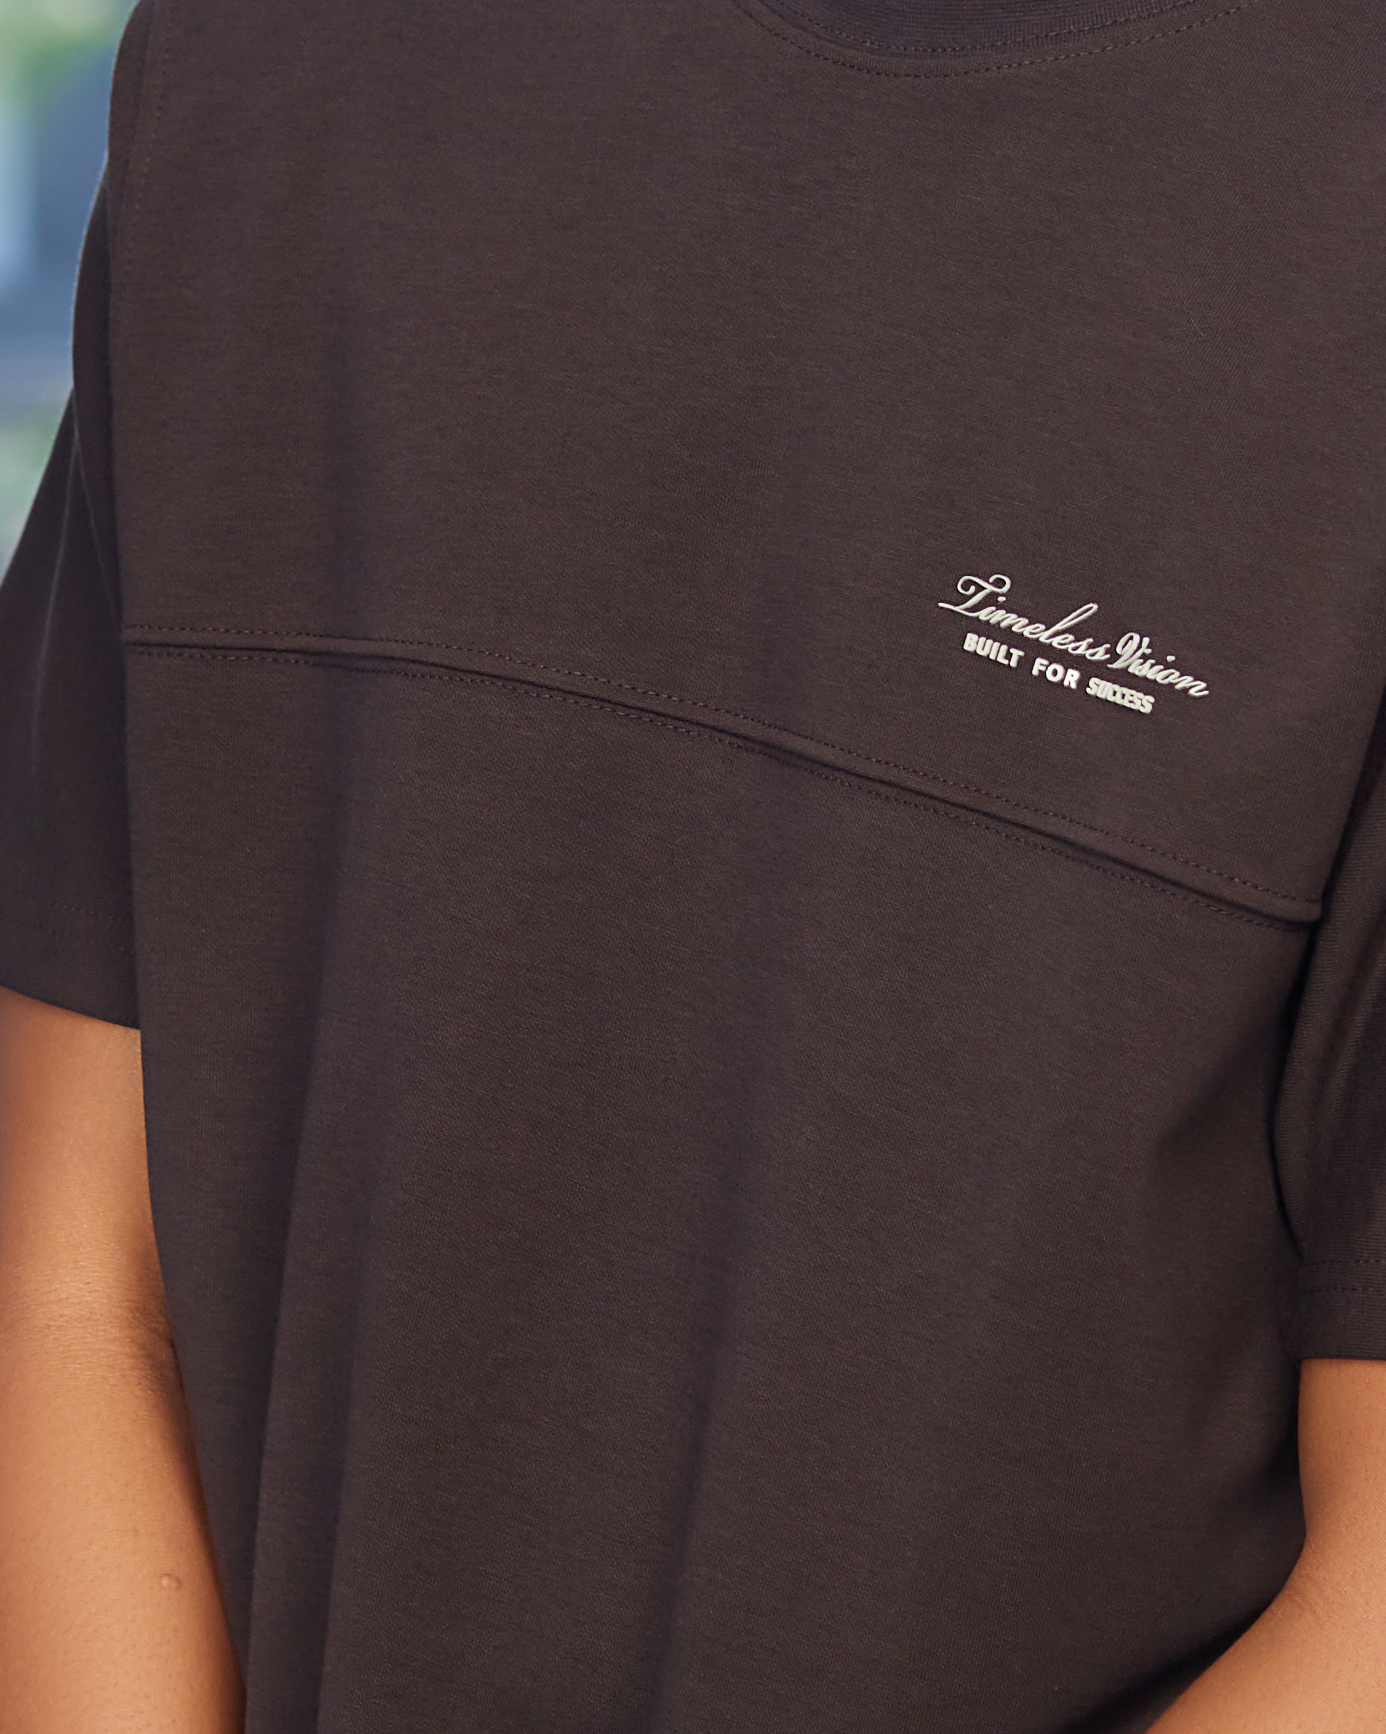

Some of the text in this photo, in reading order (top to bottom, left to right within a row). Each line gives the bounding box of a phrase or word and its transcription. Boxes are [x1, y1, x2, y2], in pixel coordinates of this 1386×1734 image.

[938, 574, 1210, 698] Timeless Vision
[963, 632, 1156, 715] BUILT FOR SUCCESS
